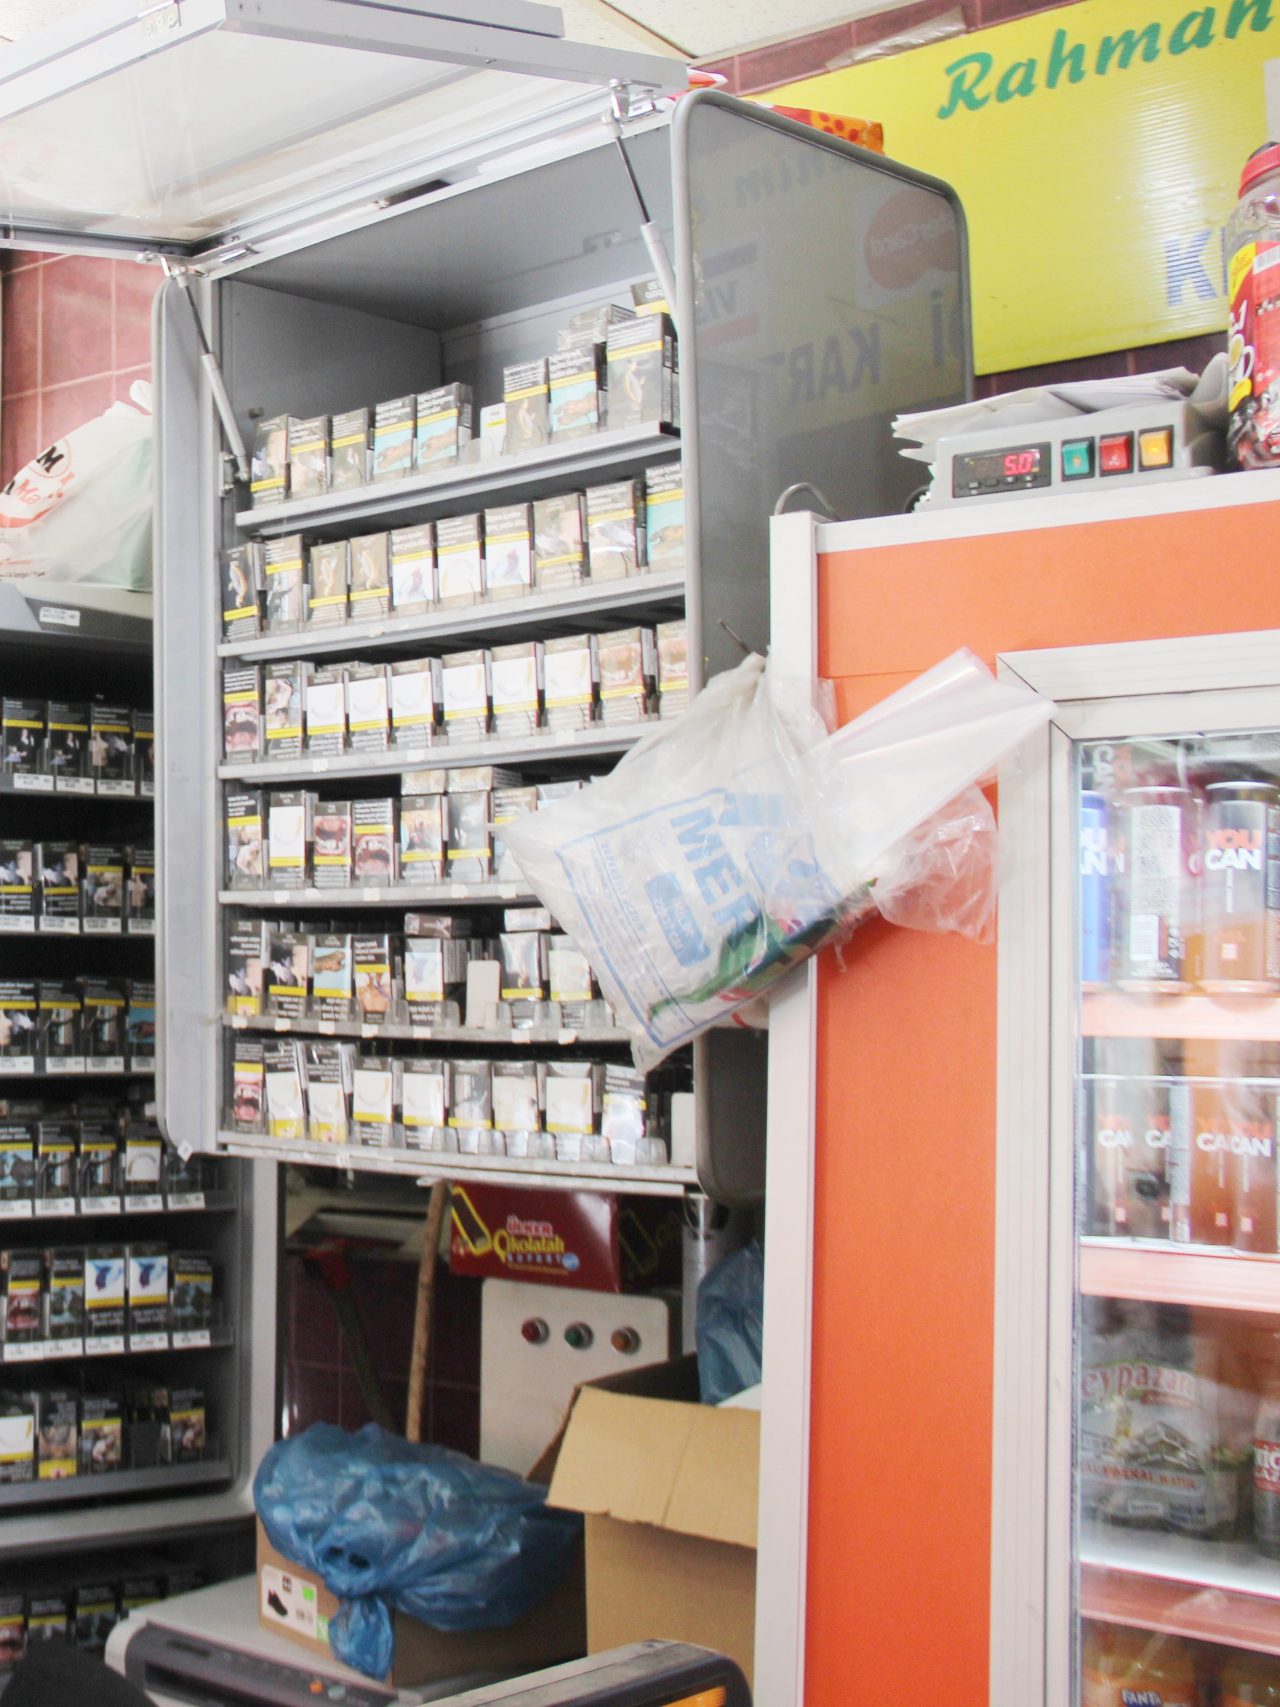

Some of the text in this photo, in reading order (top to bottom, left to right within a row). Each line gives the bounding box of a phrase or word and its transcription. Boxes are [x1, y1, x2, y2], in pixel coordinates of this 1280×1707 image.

[937, 0, 1274, 119] Rahman
[1204, 828, 1263, 849] YOU
[1204, 847, 1264, 871] CAN
